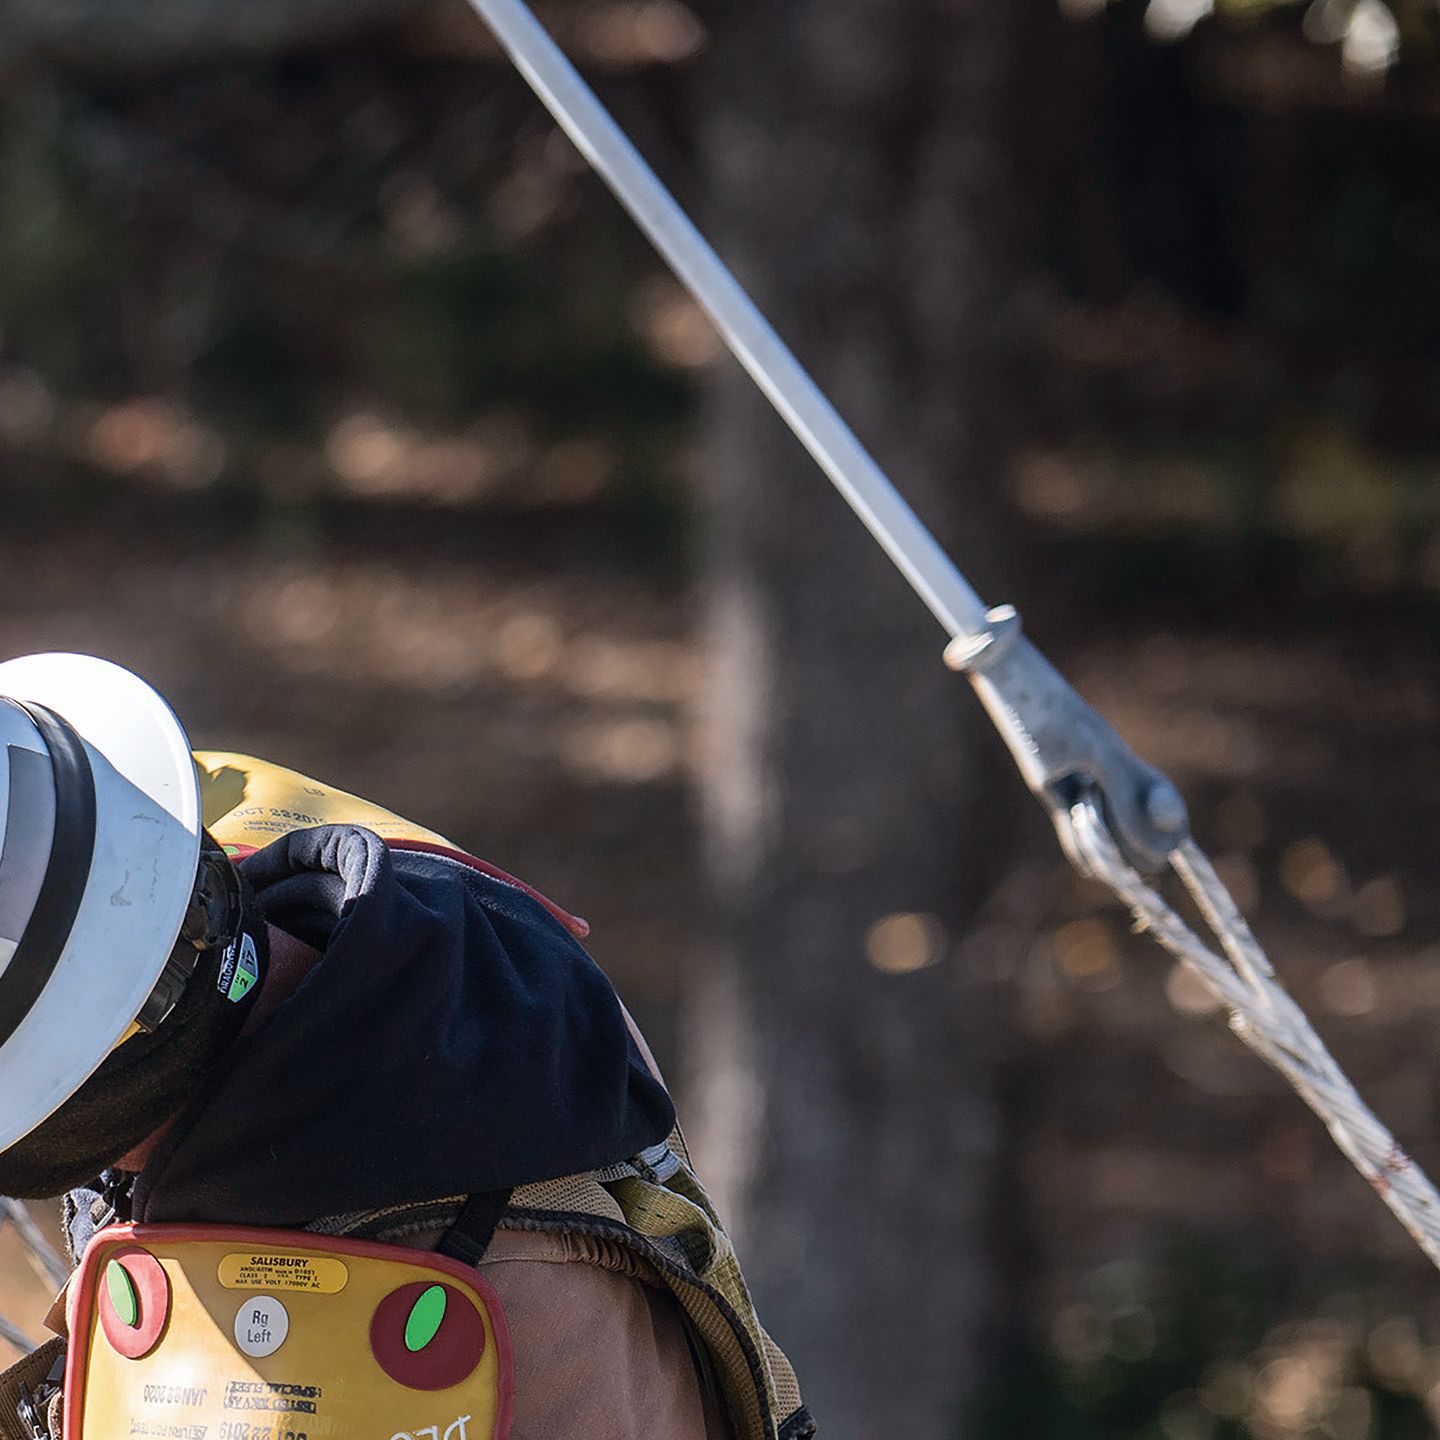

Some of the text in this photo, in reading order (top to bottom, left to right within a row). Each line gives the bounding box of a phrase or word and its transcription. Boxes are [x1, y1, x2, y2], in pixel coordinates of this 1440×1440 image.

[250, 1257, 308, 1267] SALISBURY
[252, 1310, 268, 1327] Rg
[247, 1329, 271, 1343] Left
